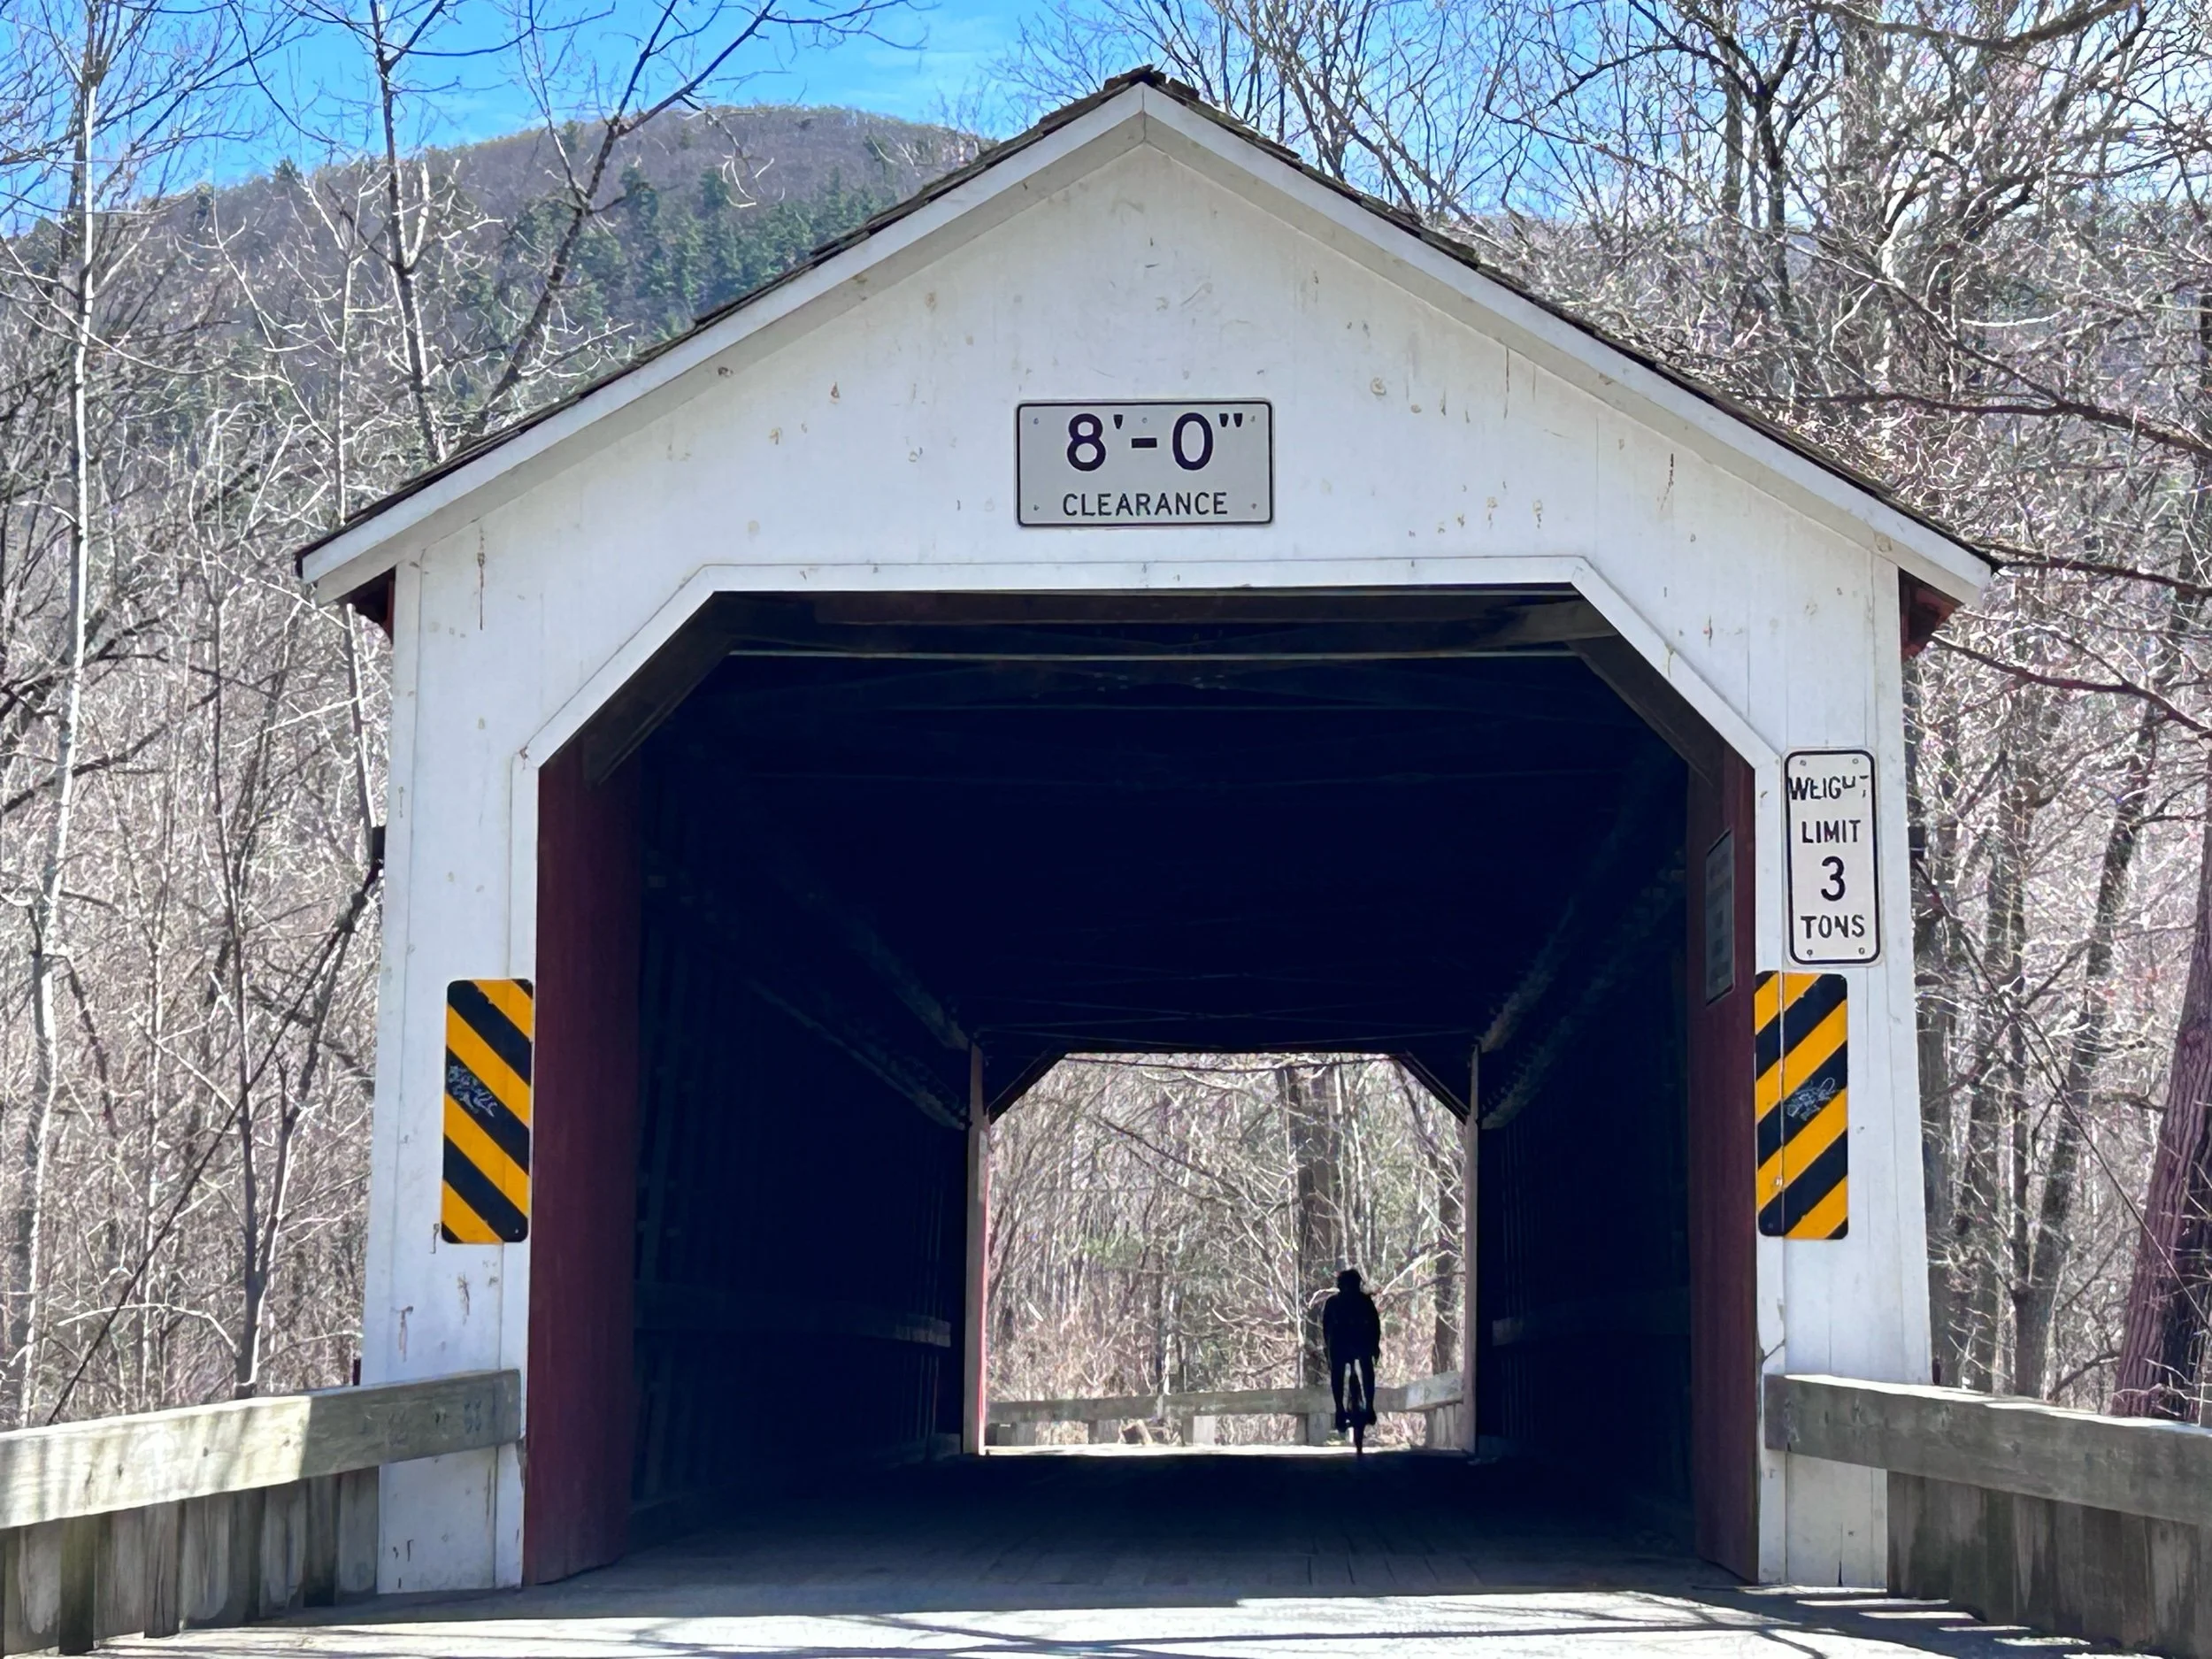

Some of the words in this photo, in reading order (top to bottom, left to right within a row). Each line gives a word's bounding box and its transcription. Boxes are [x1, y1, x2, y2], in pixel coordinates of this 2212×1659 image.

[1066, 412, 1243, 472] 8'-0"
[1063, 492, 1228, 517] CLEARANCE
[1801, 819, 1861, 843] LIMIT
[1821, 856, 1846, 902] 3
[1800, 914, 1866, 939] TONS
